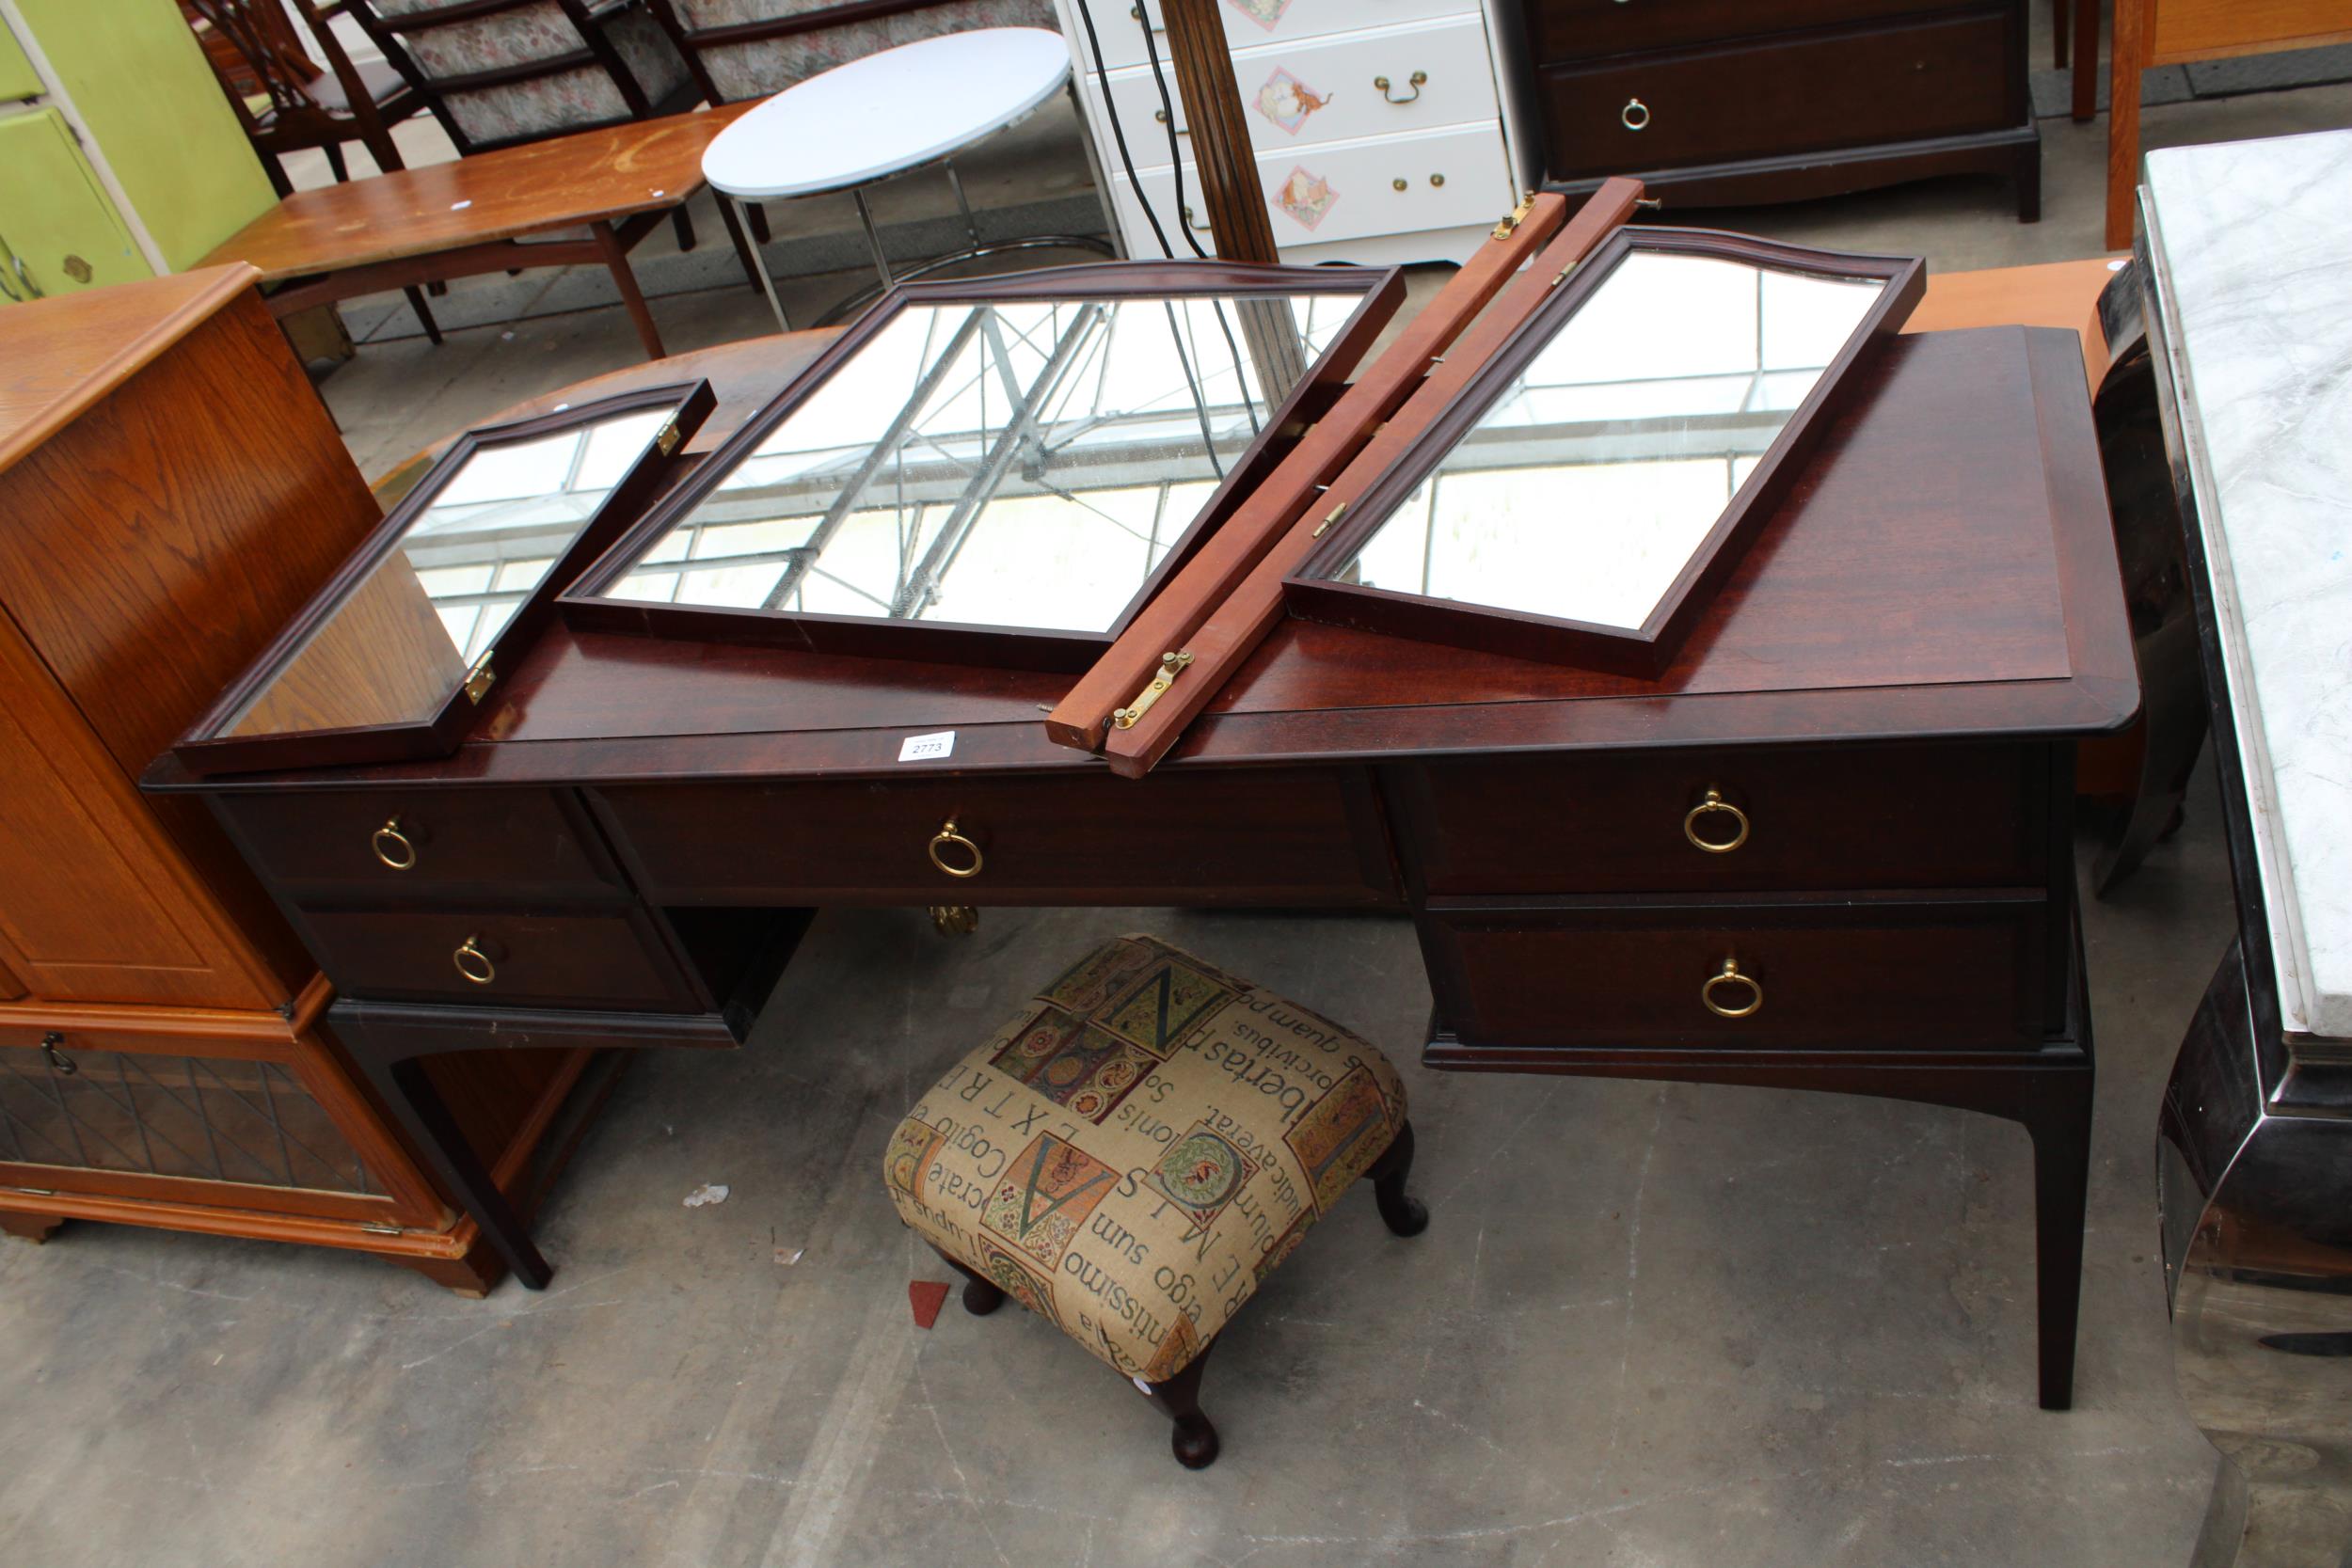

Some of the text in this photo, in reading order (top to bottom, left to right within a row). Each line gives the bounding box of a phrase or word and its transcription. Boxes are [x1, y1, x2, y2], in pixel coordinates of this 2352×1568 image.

[913, 742, 943, 753] 2773
[1021, 1132, 1116, 1240] A
[1065, 1252, 1168, 1347] ntissimo
[1091, 1212, 1201, 1324] ergo sum
